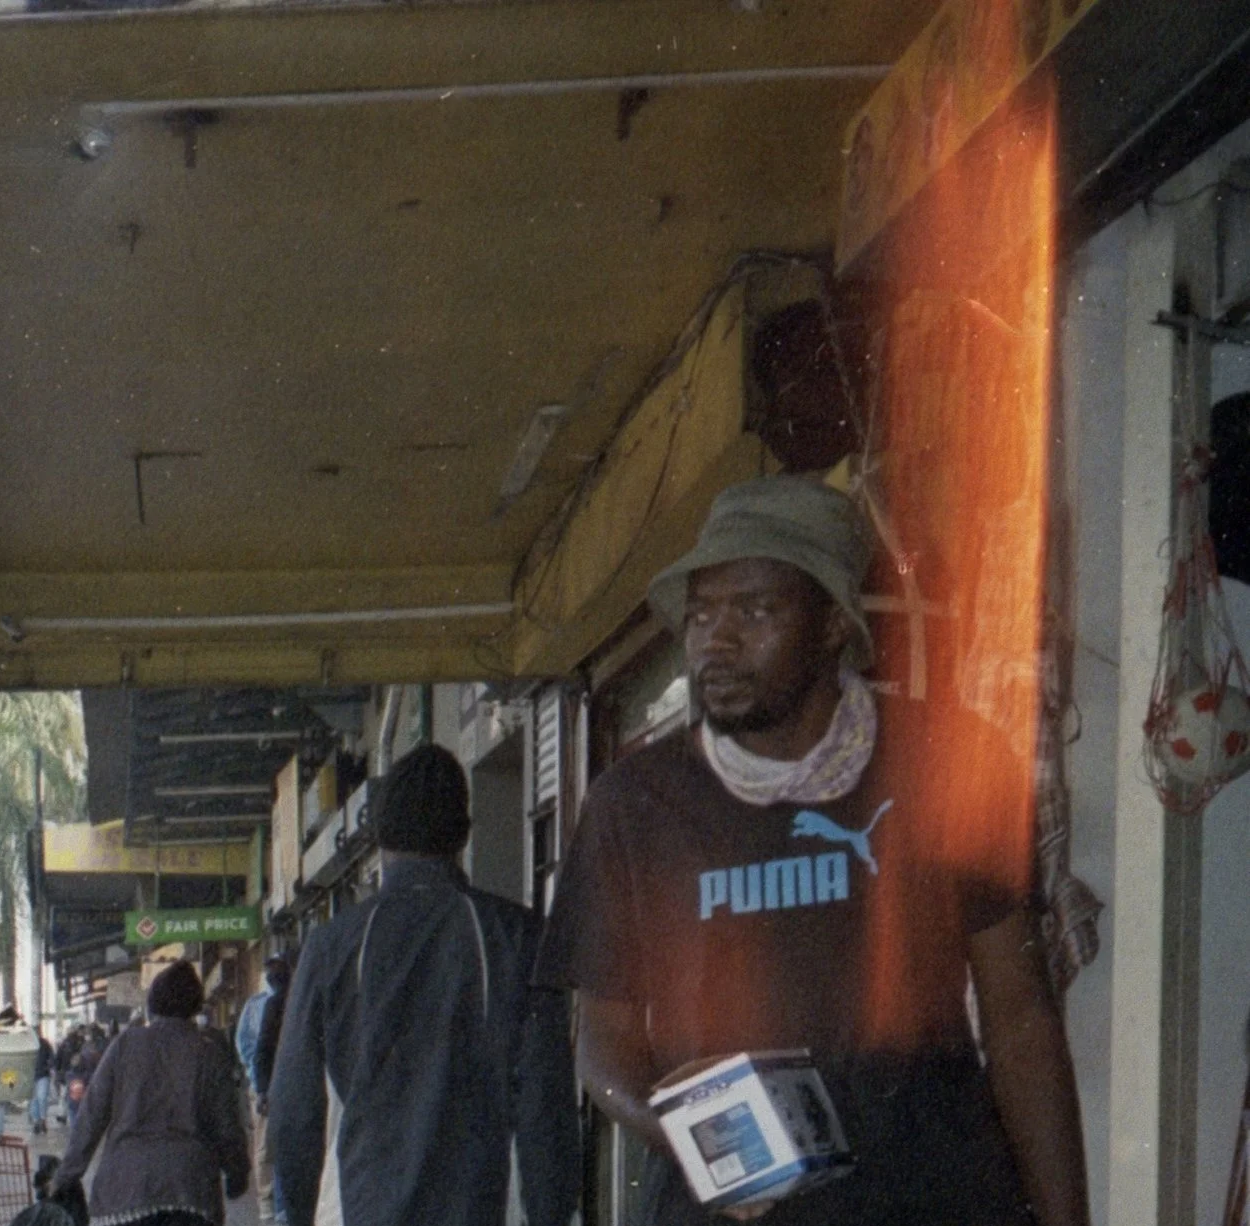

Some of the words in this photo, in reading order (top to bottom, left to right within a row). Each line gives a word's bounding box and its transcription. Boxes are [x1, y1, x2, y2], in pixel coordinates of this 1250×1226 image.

[699, 852, 849, 920] PUMA
[165, 920, 199, 933] FAIR
[205, 917, 248, 931] PRICE
